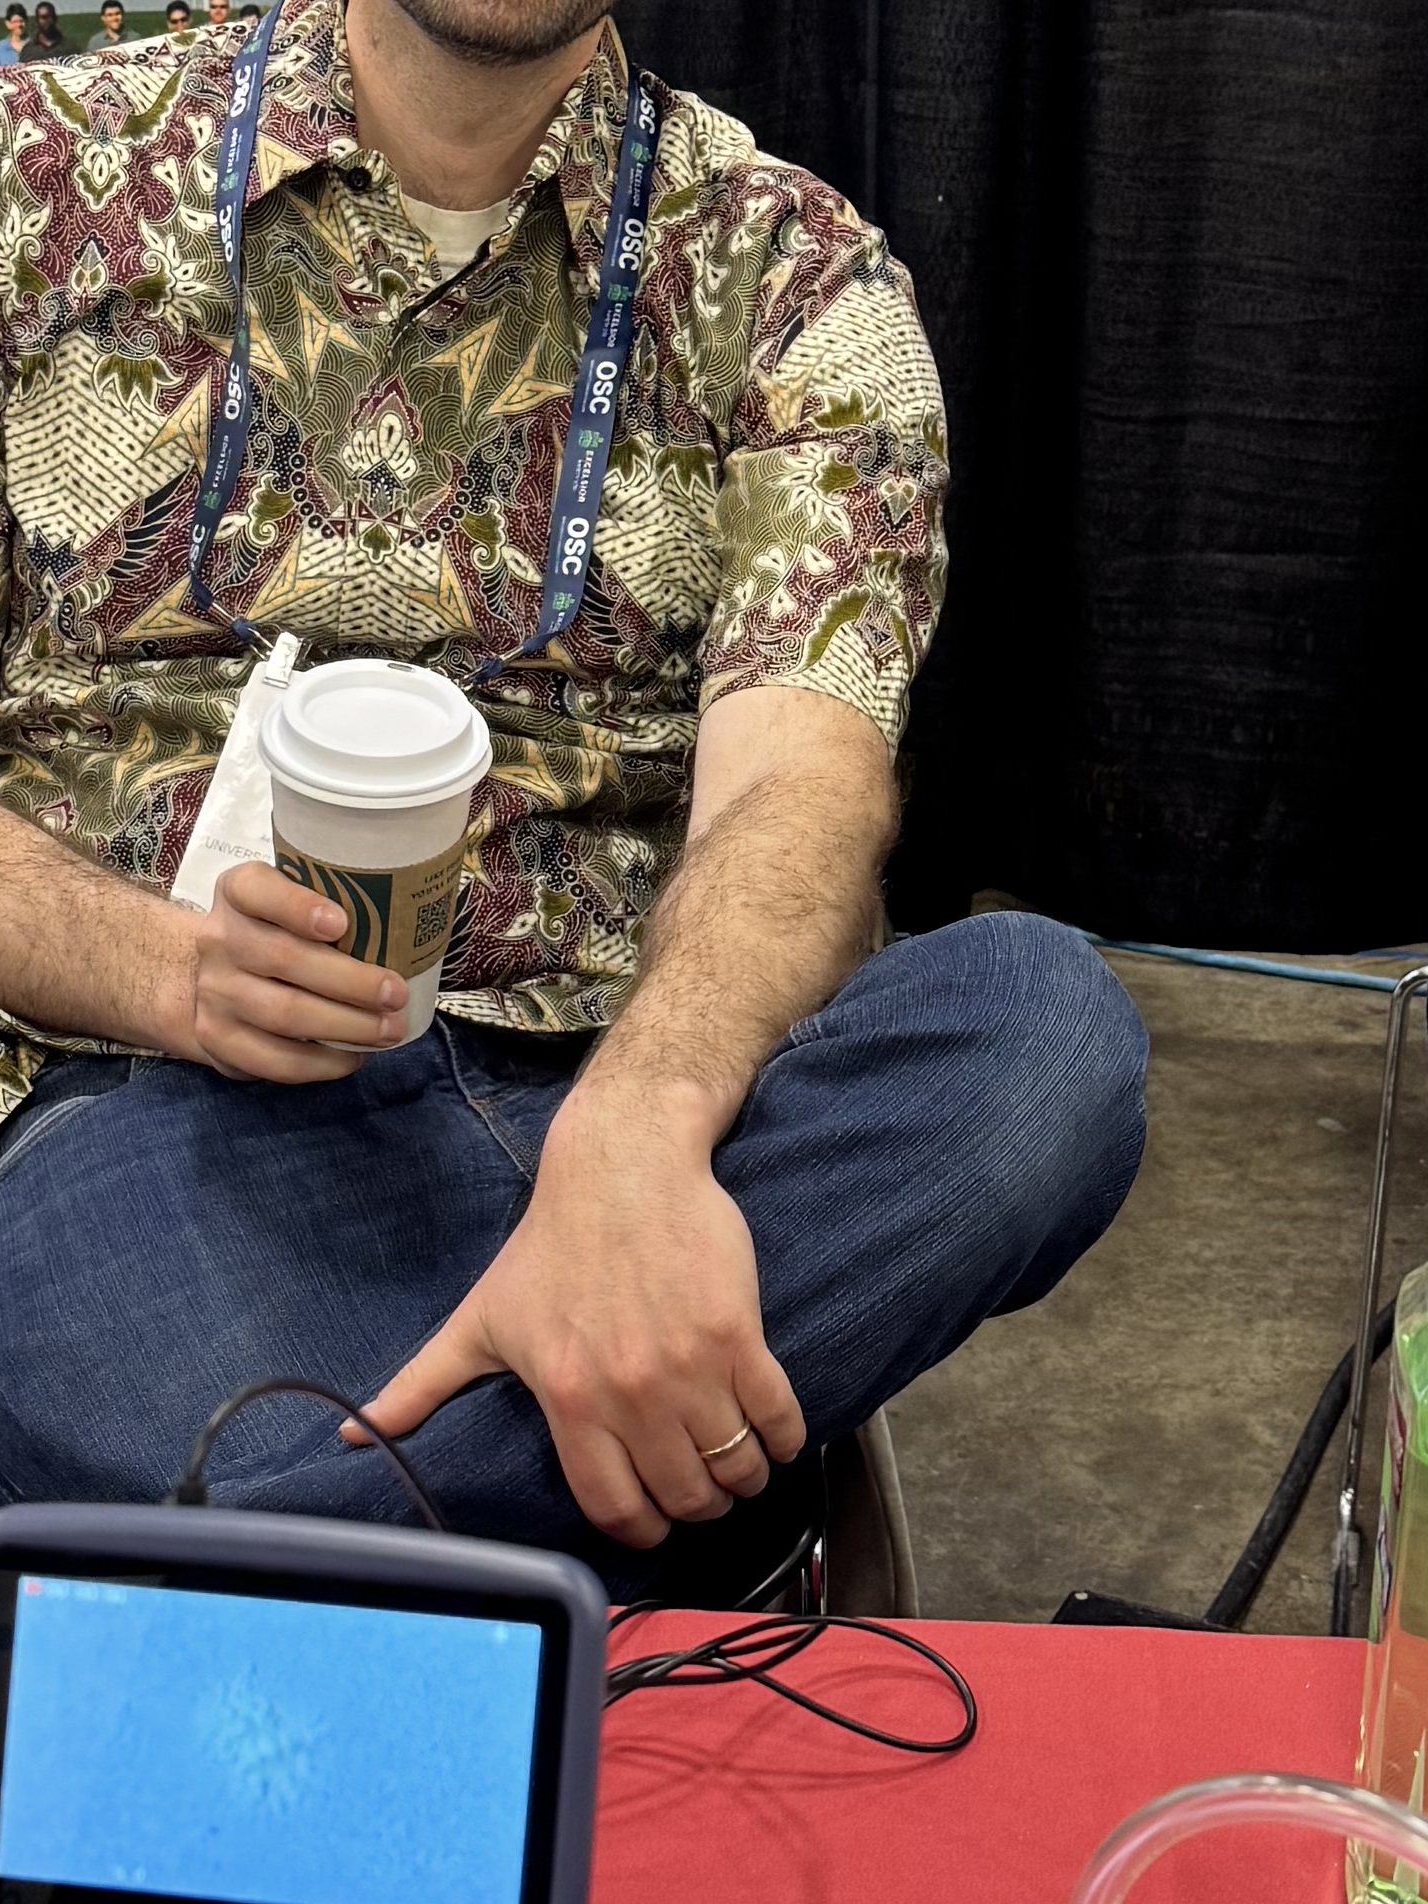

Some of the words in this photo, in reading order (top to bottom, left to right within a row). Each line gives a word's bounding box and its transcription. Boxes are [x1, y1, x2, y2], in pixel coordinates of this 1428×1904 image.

[230, 64, 253, 116] OSC
[218, 204, 235, 260] OSC
[618, 219, 644, 271] OSC
[224, 360, 244, 419] OSC
[588, 361, 618, 414] OSC
[562, 516, 590, 576] OSC
